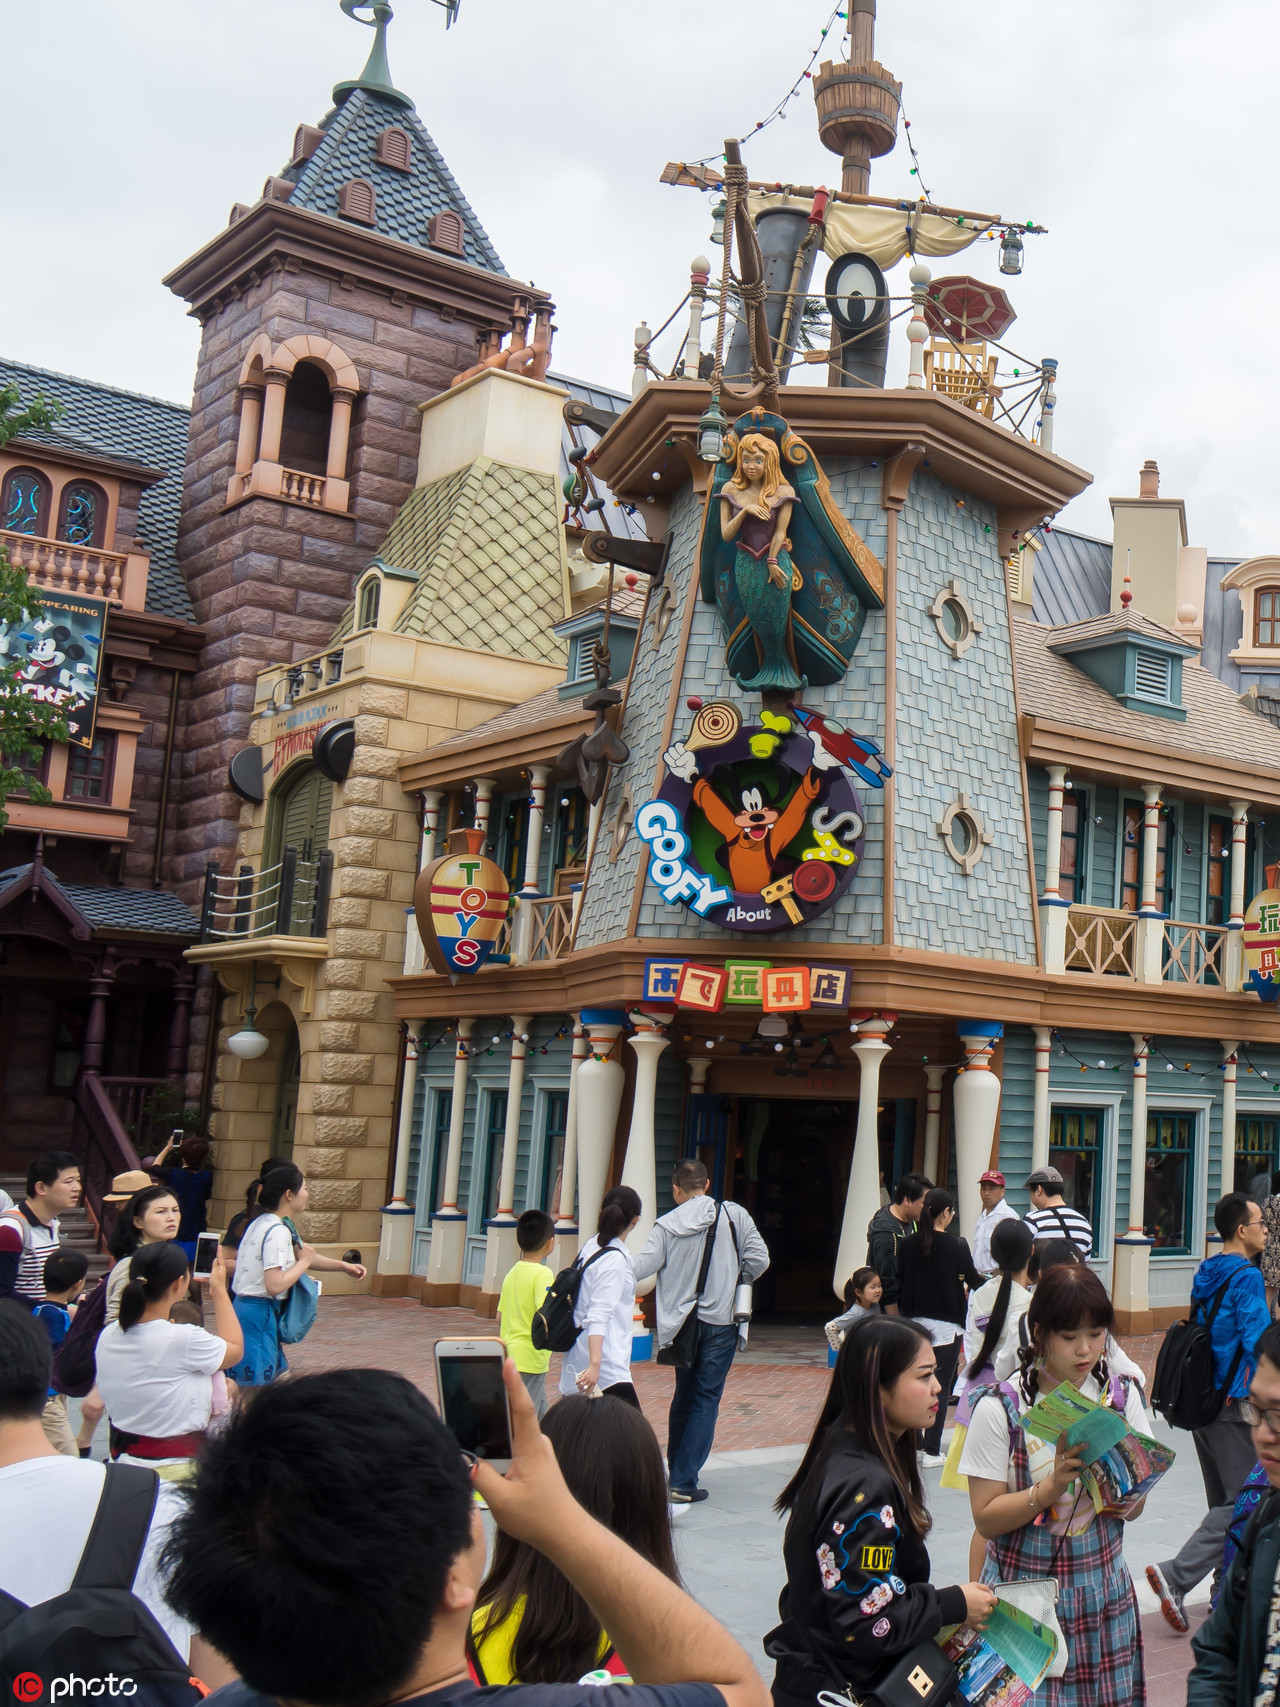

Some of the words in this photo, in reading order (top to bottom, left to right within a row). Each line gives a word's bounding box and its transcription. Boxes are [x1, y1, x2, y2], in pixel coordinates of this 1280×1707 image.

[452, 860, 488, 967] TOYS
[635, 799, 734, 917] GOOFY
[726, 906, 772, 922] About
[760, 806, 865, 925] TOYS
